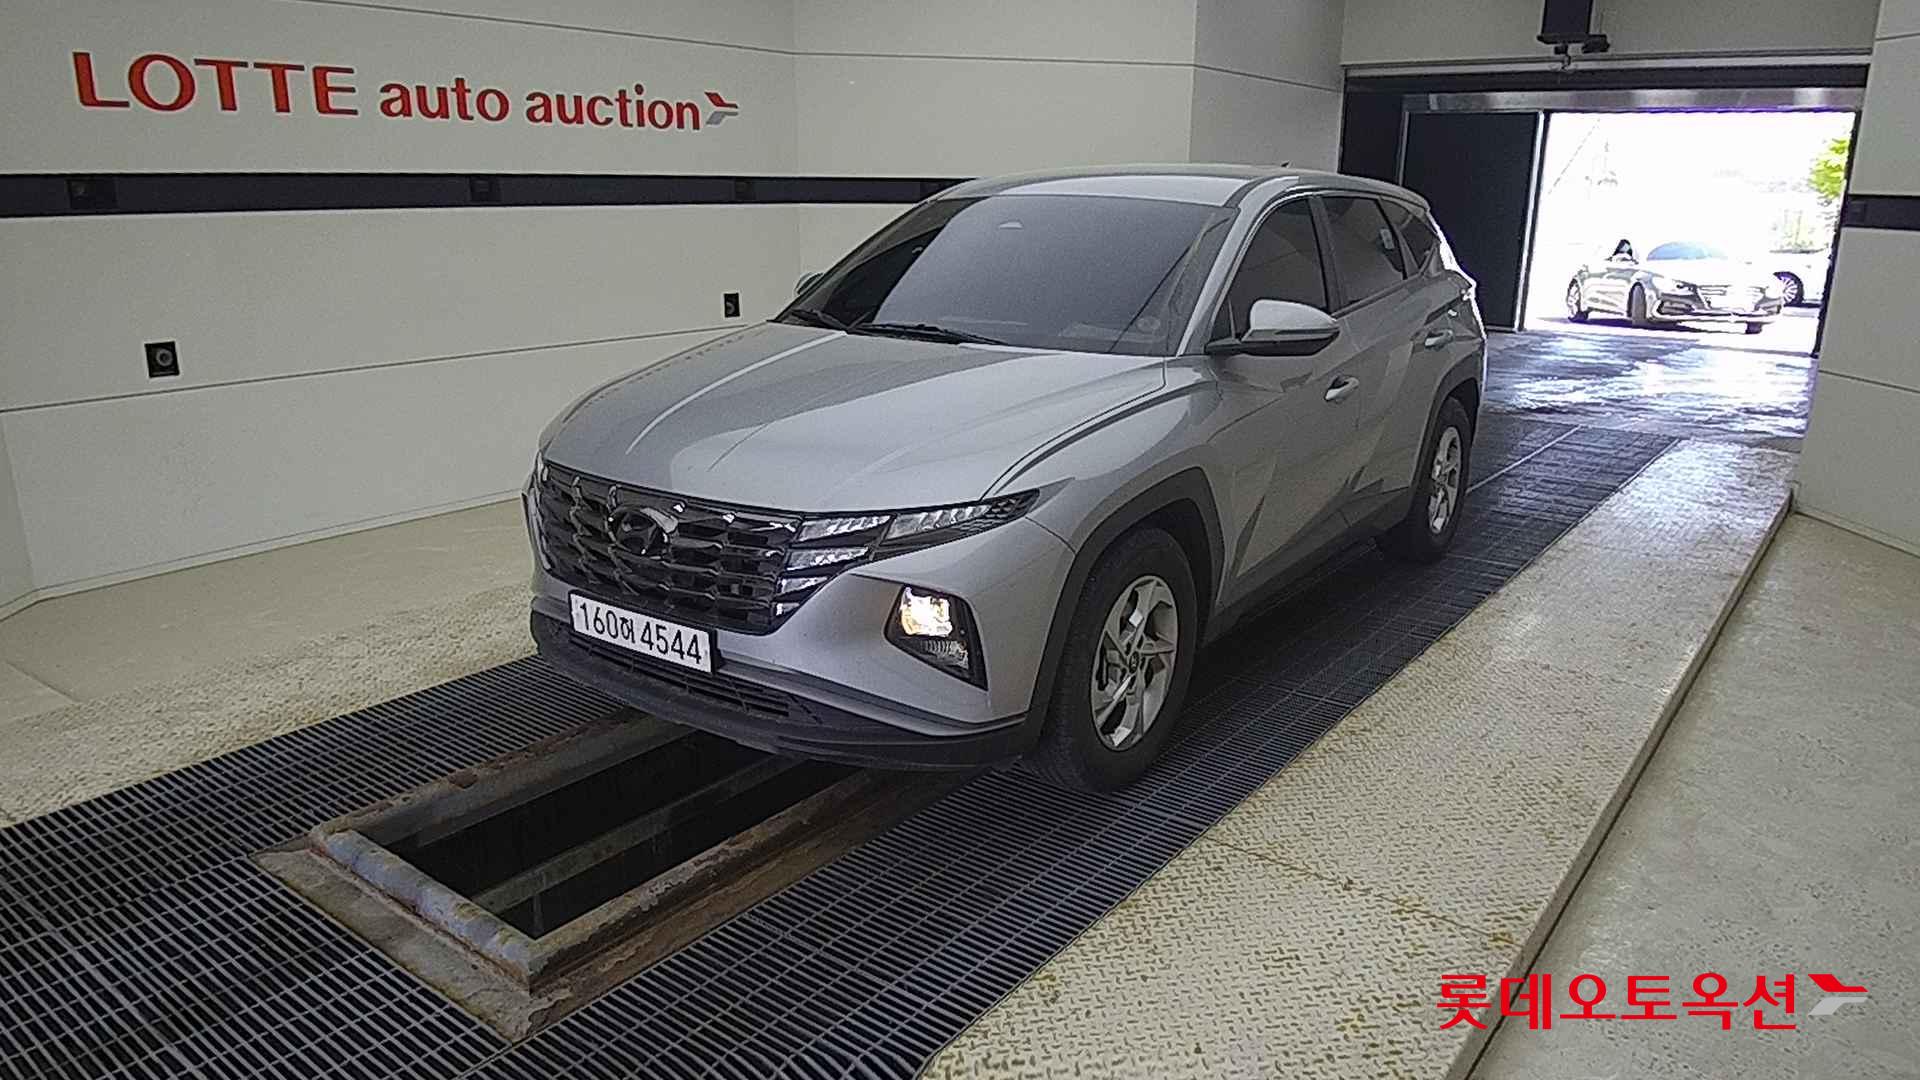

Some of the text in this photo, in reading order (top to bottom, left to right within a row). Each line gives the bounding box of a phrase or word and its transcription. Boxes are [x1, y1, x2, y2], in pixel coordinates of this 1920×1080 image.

[72, 51, 701, 130] LOTTE auto auction
[640, 623, 701, 664] 4544
